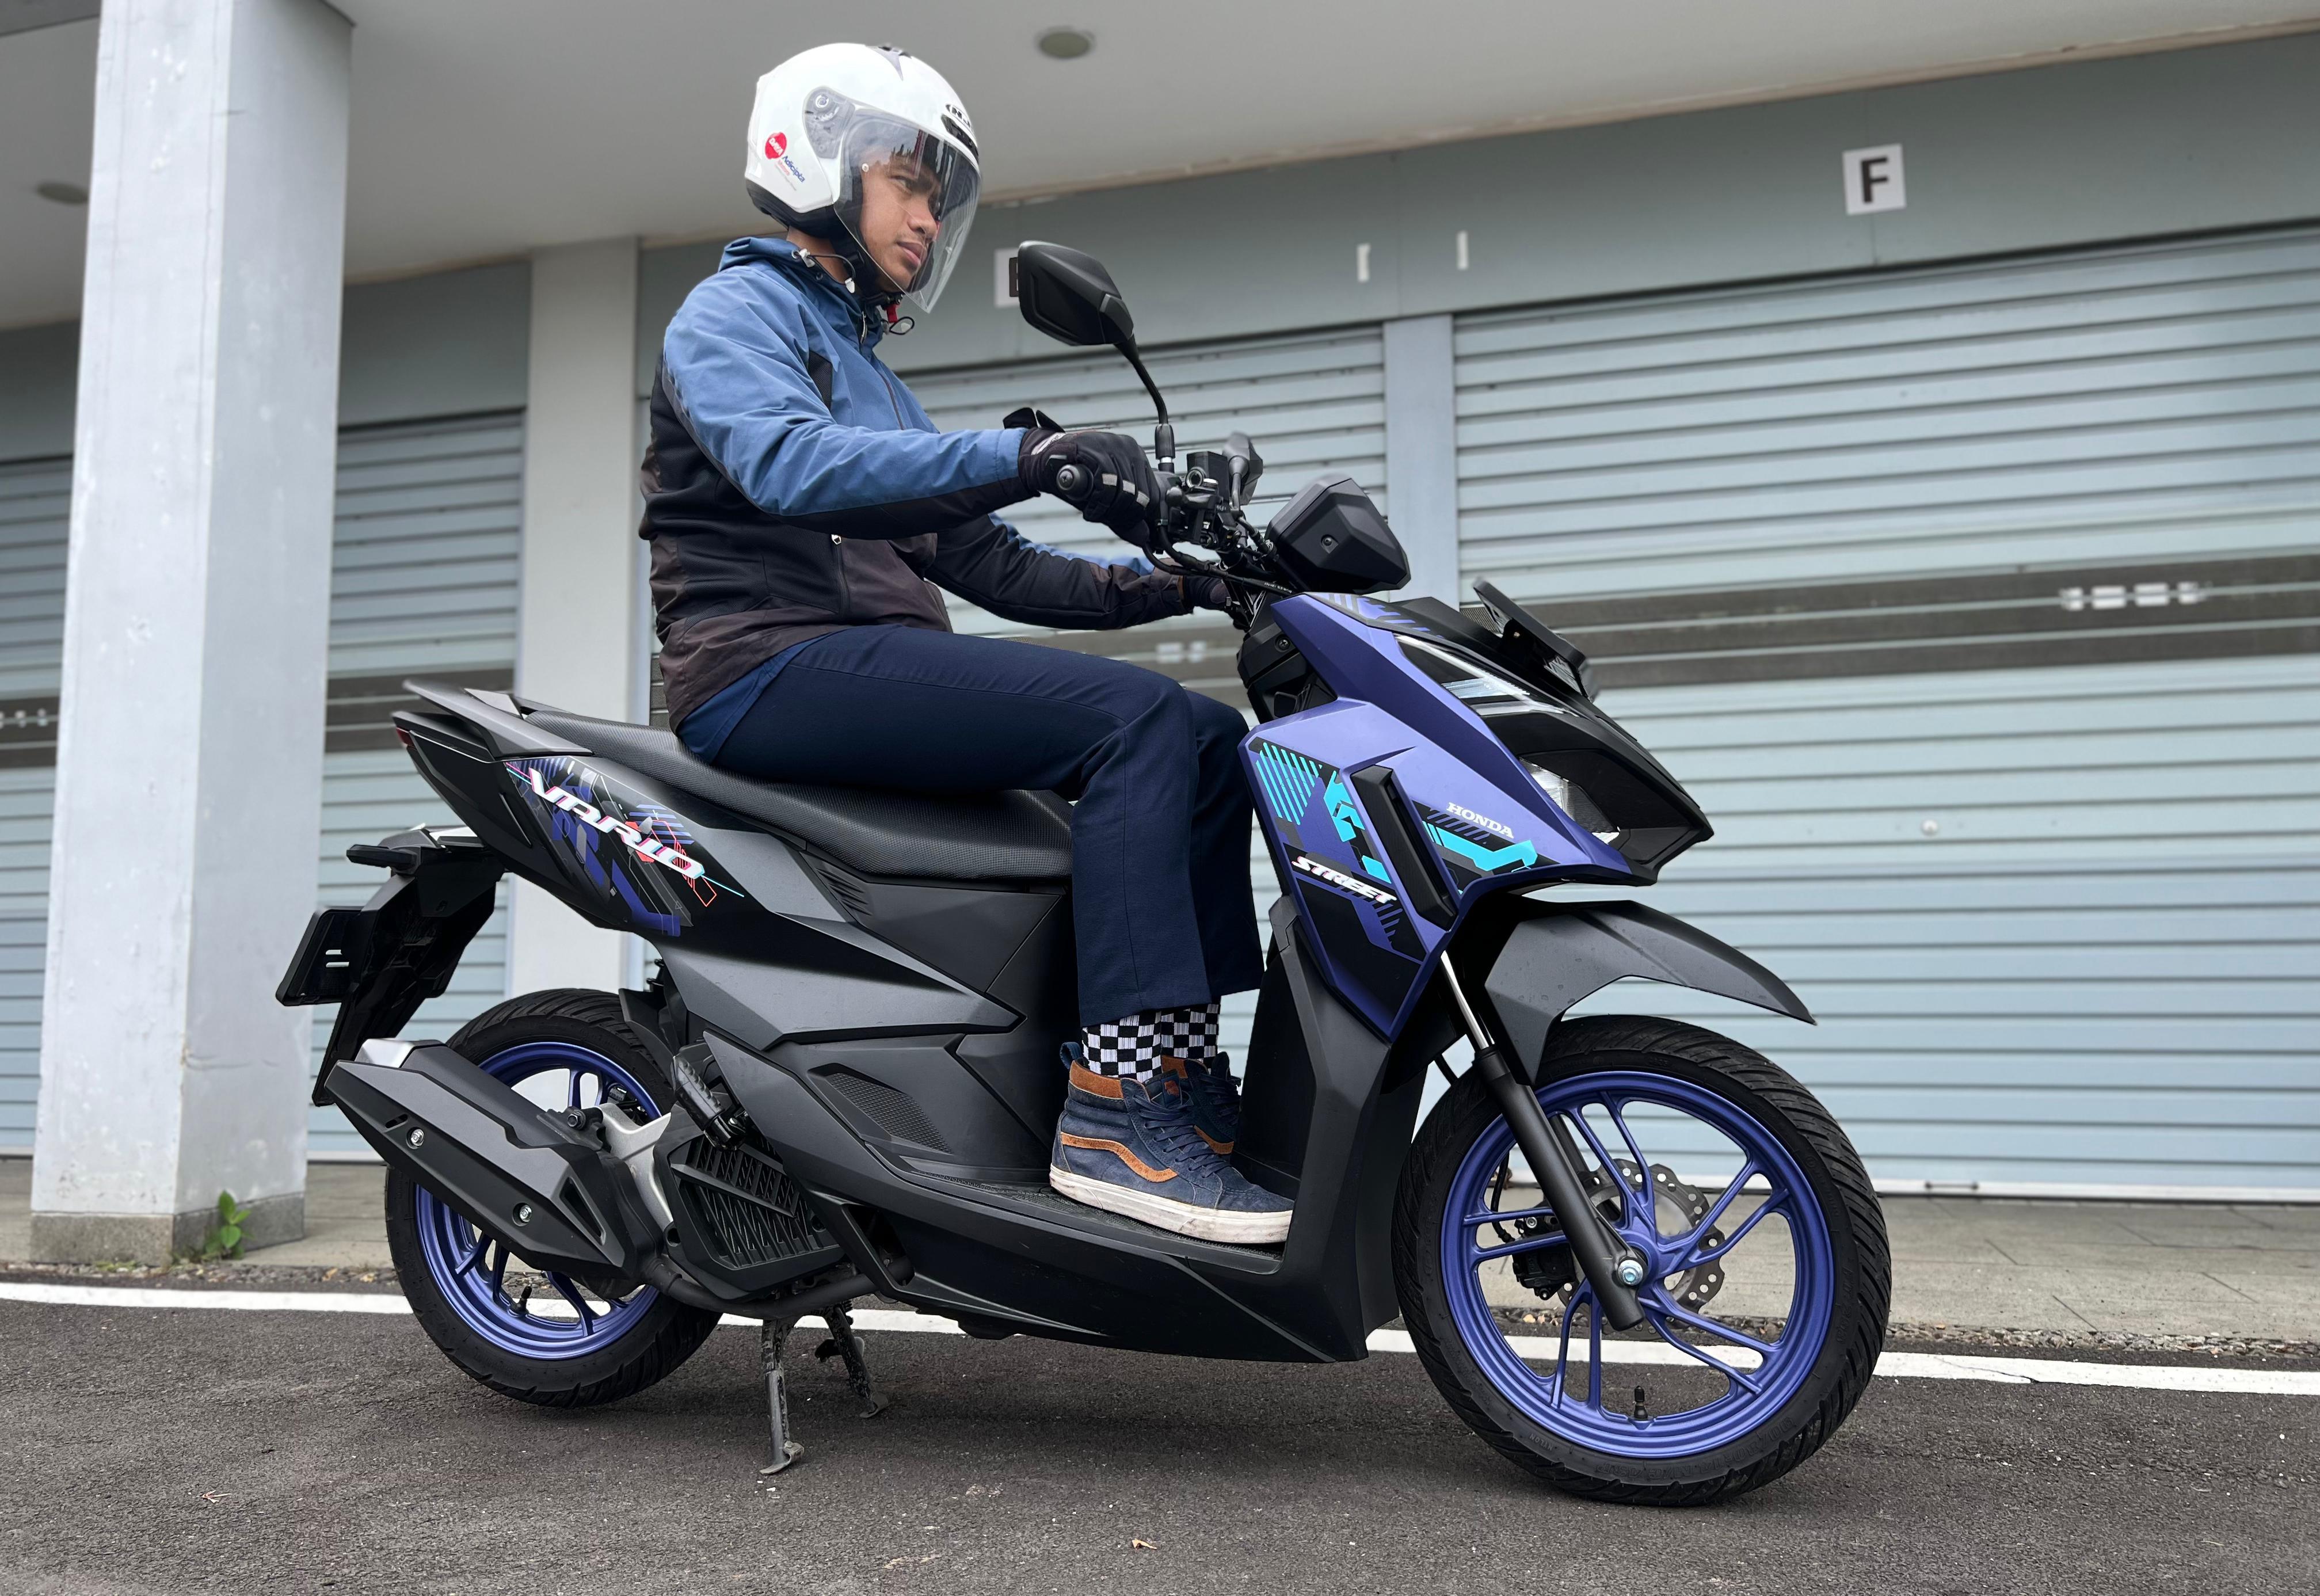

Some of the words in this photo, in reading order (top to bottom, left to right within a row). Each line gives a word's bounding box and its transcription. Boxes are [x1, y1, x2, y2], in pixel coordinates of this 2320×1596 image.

[1860, 156, 1888, 203] F
[1446, 802, 1514, 839] HONDA
[1291, 855, 1397, 904] STREET
[1529, 1433, 1553, 1451] NYLON
